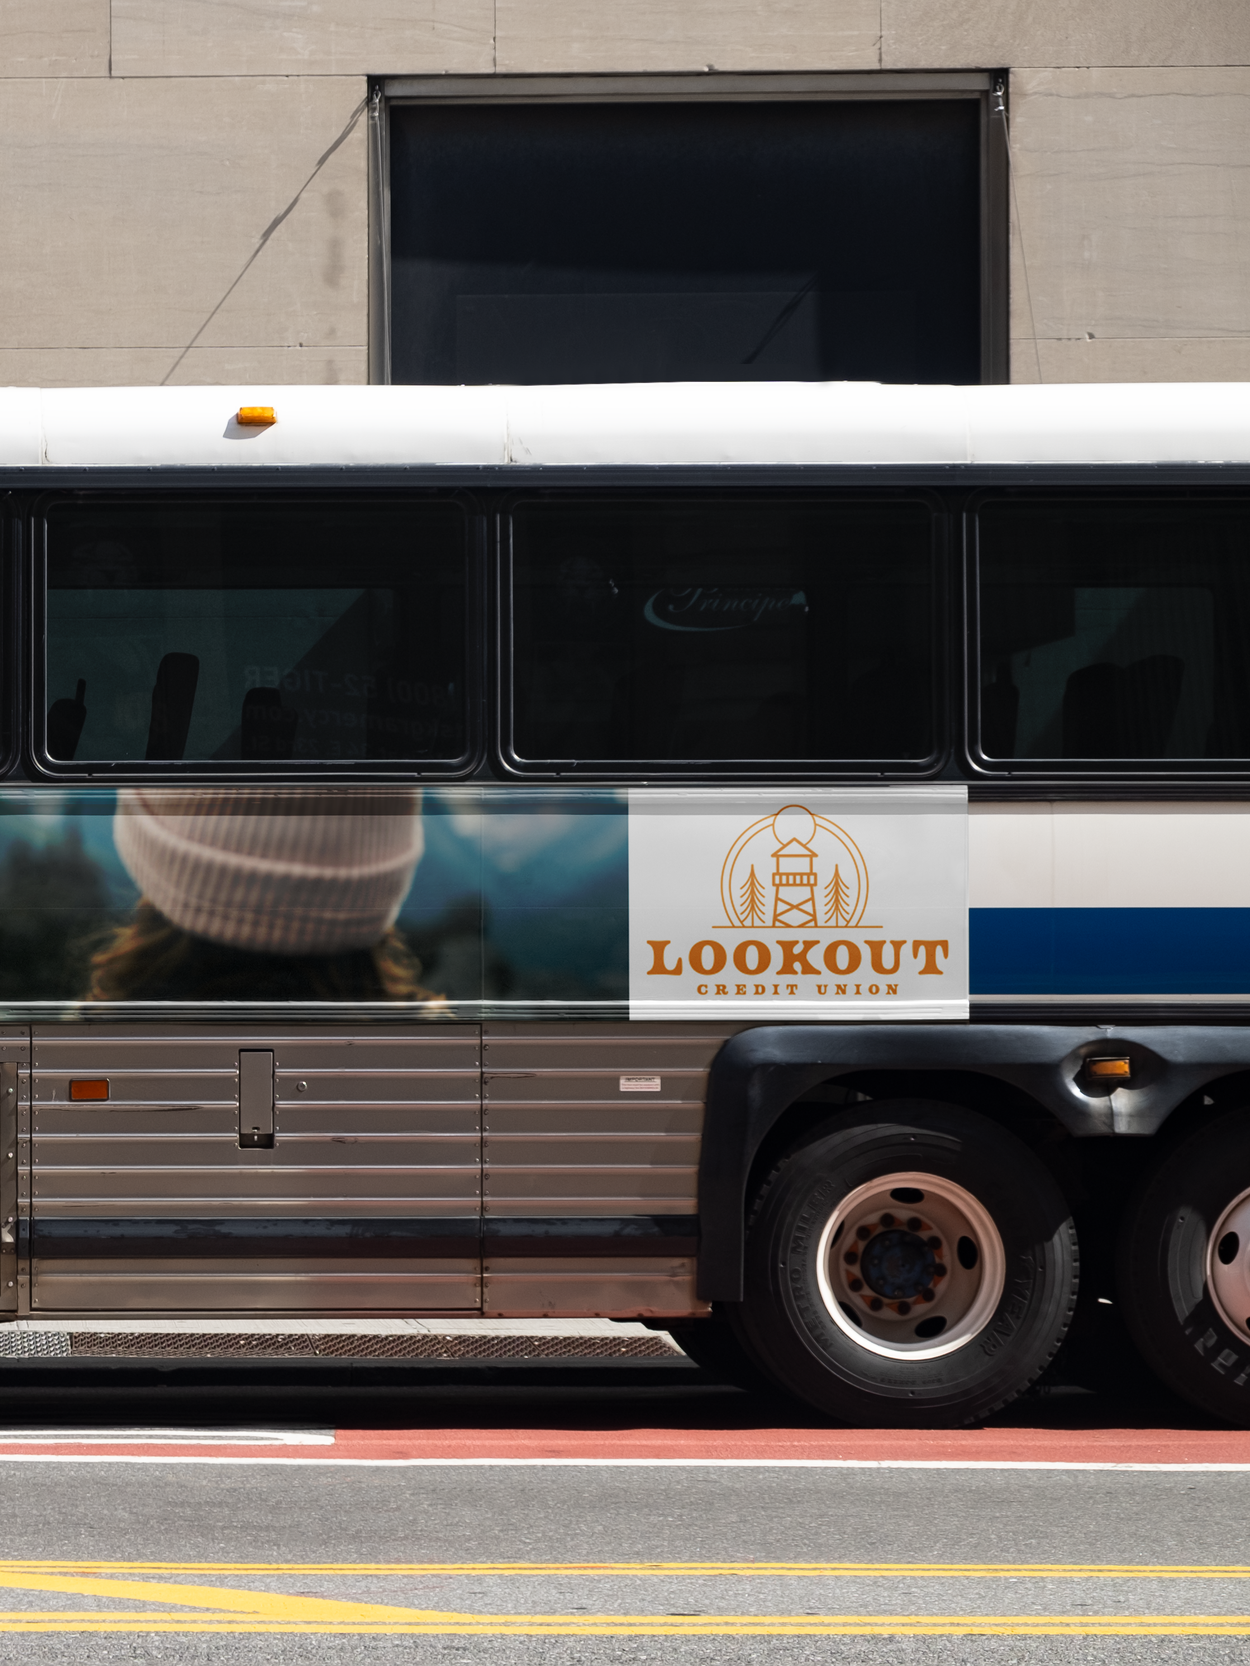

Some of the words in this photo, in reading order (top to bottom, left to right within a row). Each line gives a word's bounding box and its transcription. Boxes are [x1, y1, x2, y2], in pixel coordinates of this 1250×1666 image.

[646, 939, 950, 976] LOOKOUT
[696, 983, 799, 996] CREDIT
[816, 983, 900, 996] UNION
